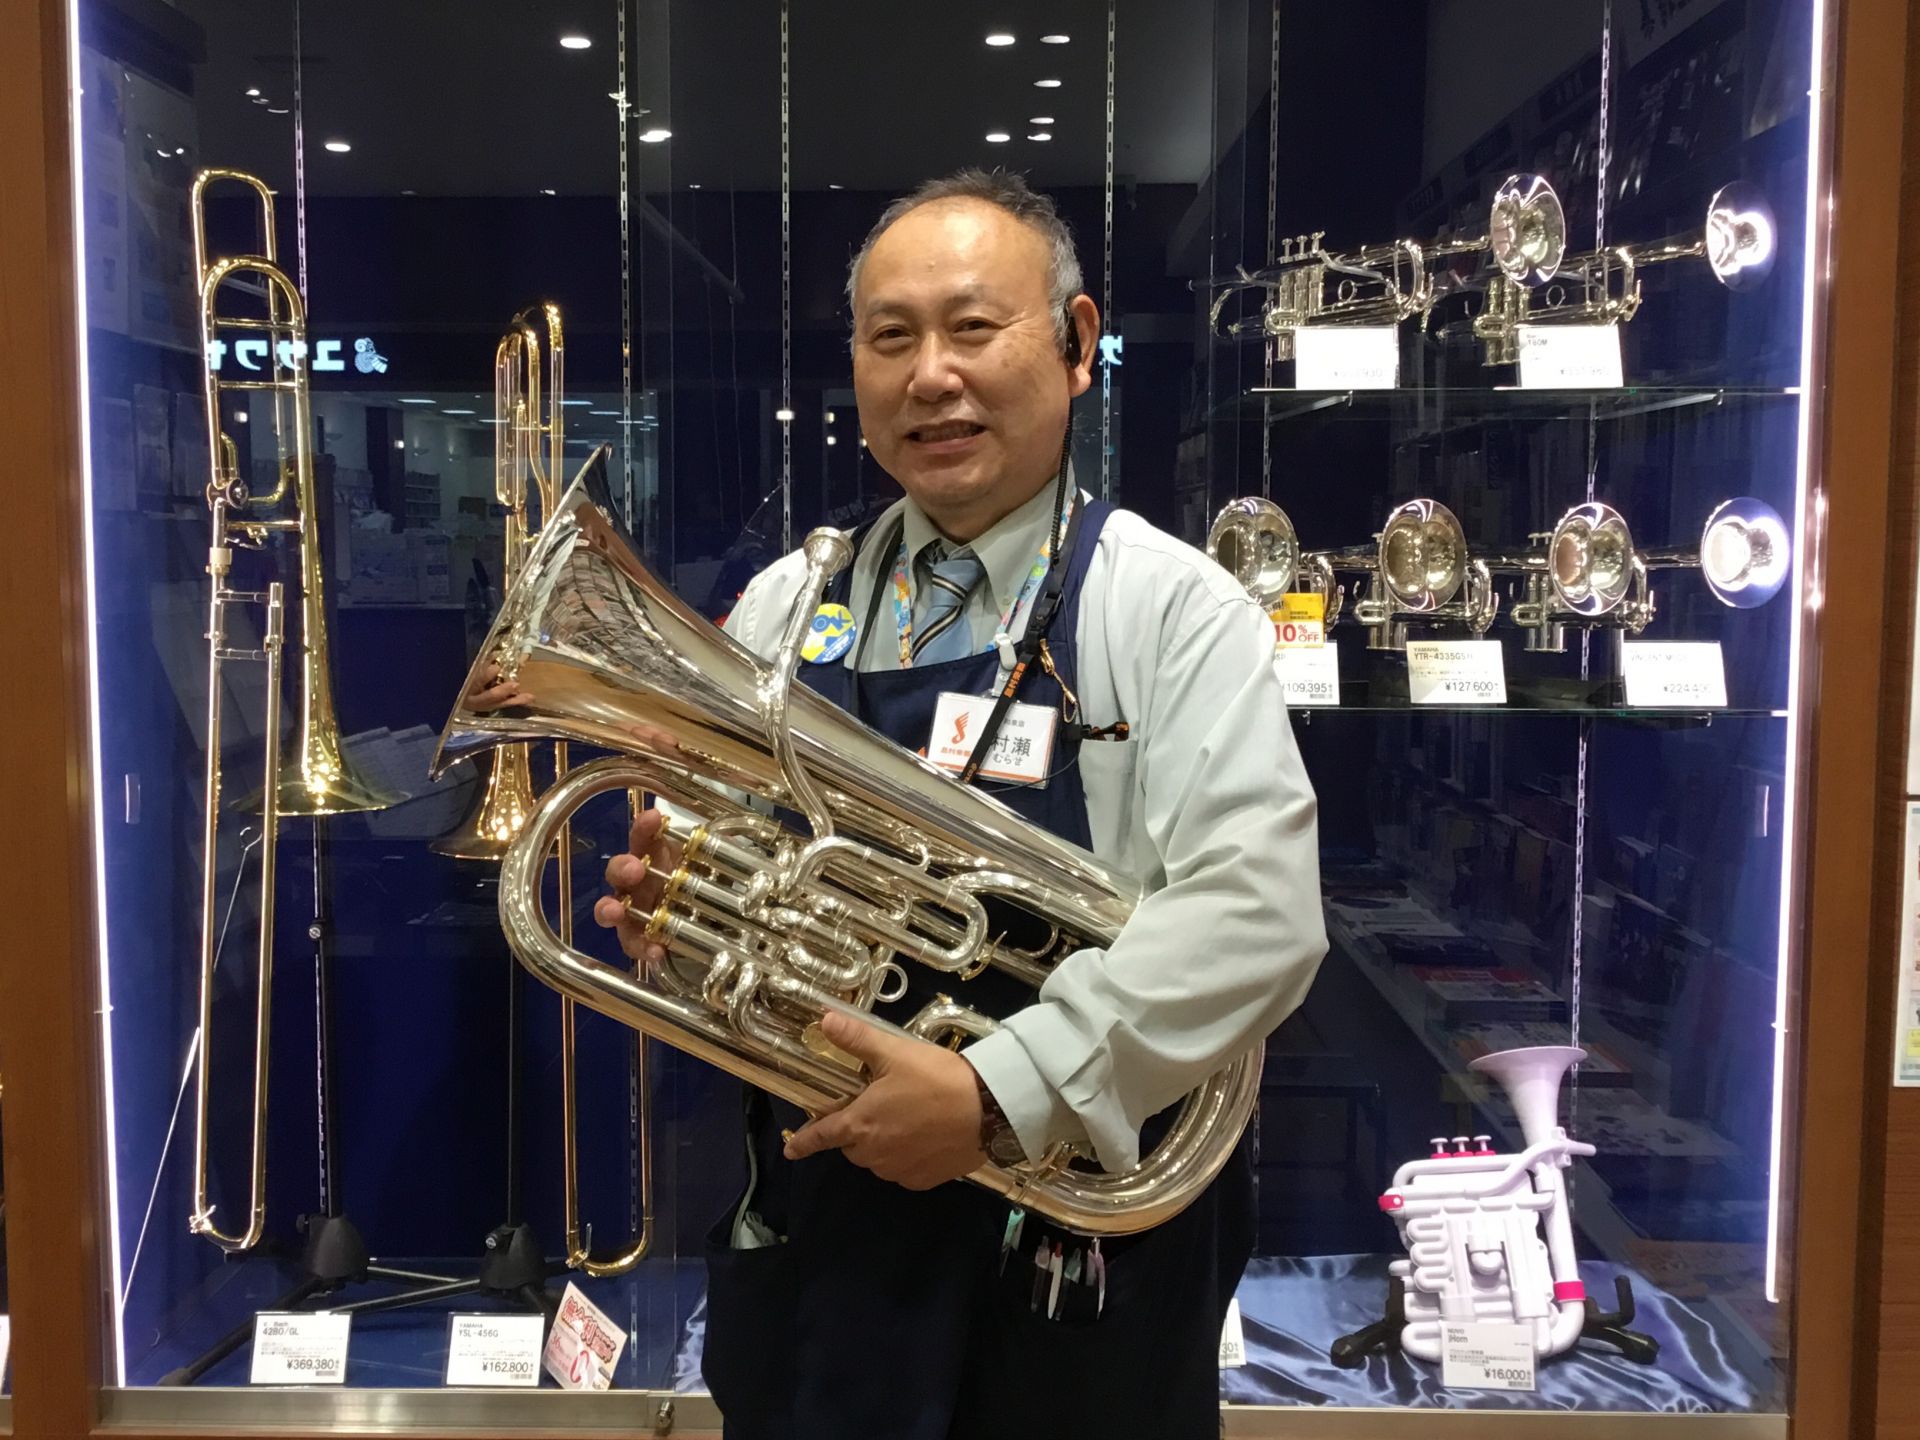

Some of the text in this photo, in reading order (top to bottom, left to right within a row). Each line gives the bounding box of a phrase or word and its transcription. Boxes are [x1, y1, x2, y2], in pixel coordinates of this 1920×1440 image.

[1298, 634, 1319, 642] OFF
[992, 752, 1023, 766] むらせ
